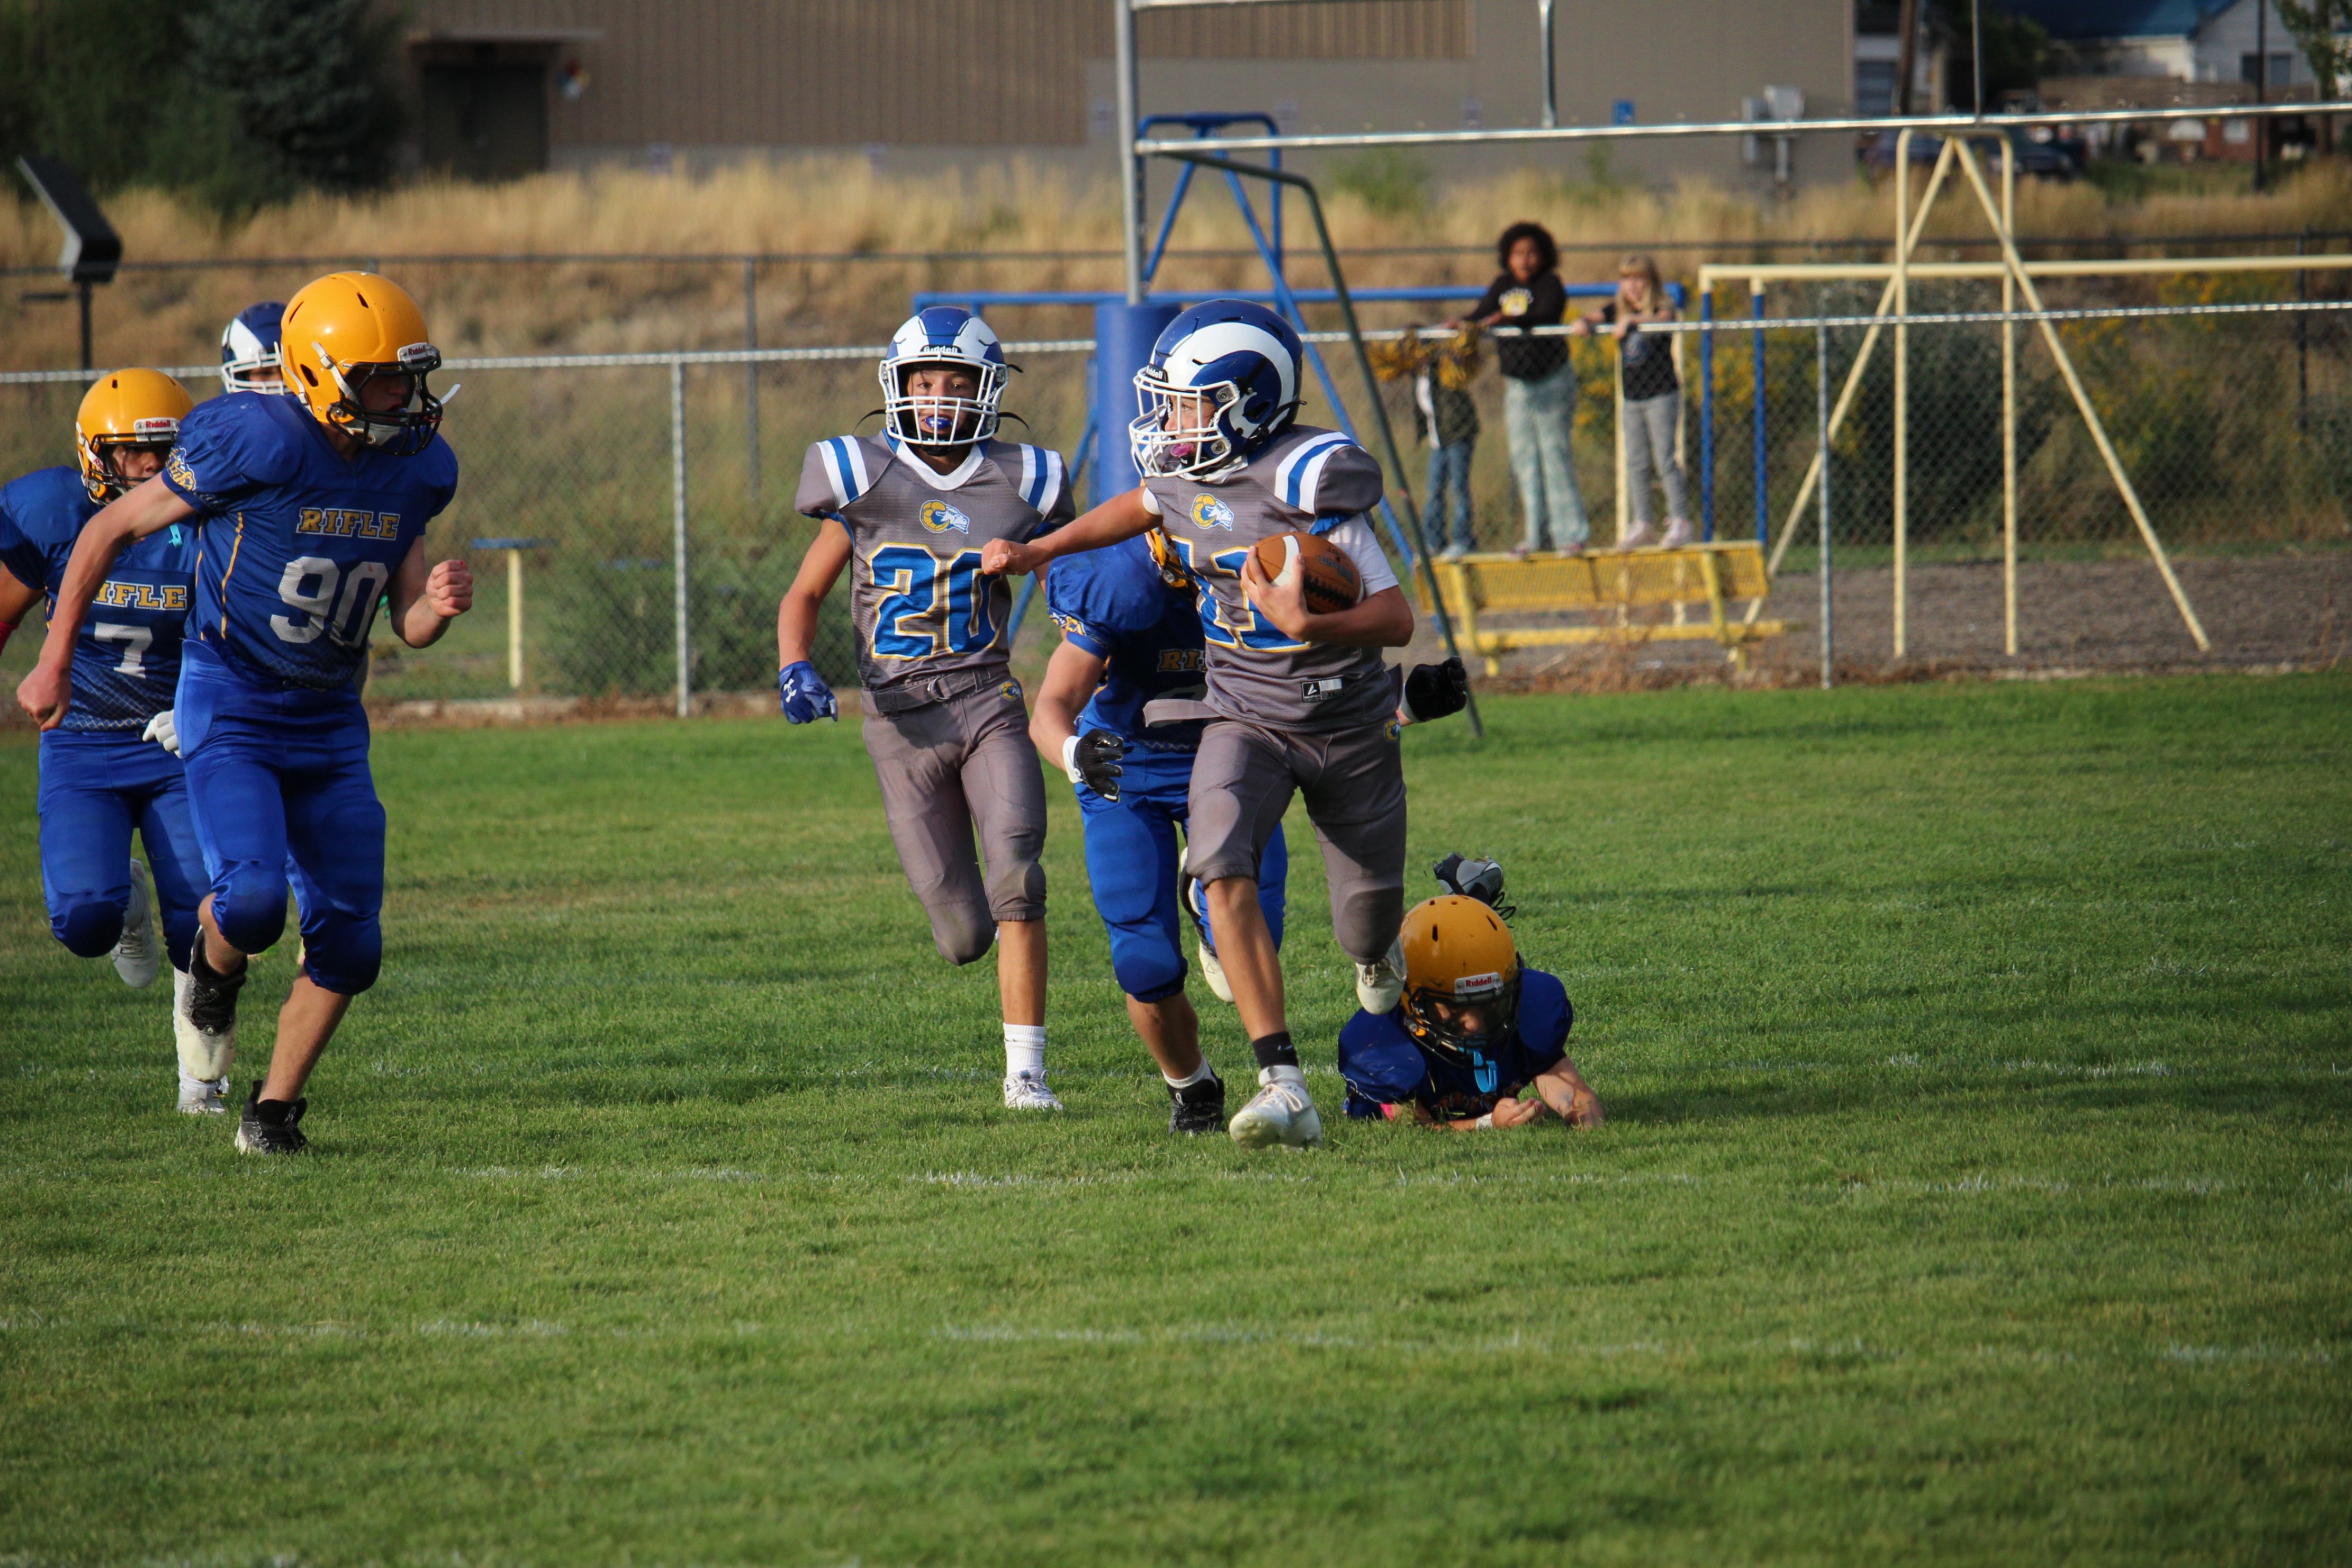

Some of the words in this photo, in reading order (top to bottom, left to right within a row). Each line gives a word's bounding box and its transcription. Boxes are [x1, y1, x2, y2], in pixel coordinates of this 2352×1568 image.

[146, 420, 170, 428] Riddell
[296, 507, 401, 541] RIFLE
[93, 580, 186, 610] IFLE
[270, 556, 389, 649] 90
[868, 542, 1002, 661] 20
[94, 621, 154, 679] 7
[1466, 976, 1492, 987] Riddell
